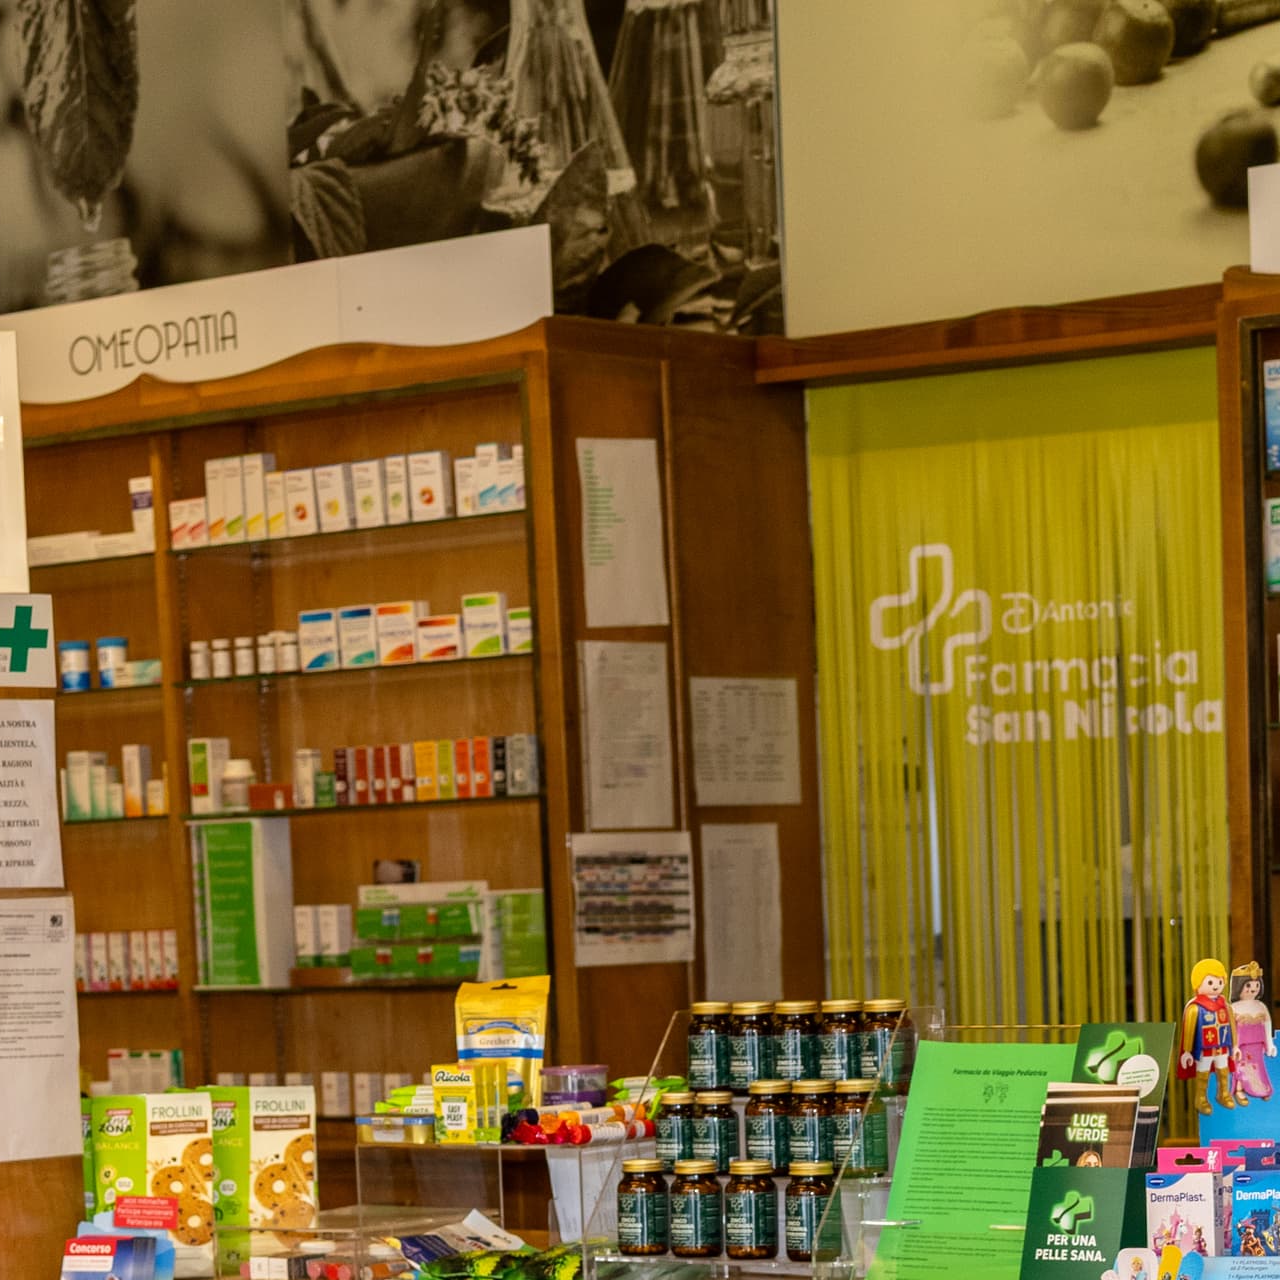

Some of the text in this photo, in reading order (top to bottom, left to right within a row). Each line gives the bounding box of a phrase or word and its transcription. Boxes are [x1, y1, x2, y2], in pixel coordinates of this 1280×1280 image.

[69, 310, 238, 376] OMEOPATIA
[966, 704, 1052, 745] San
[435, 1071, 471, 1082] Ricola
[152, 1106, 202, 1117] FROLLINI
[255, 1100, 306, 1111] FROLLINI
[1073, 1114, 1106, 1128] LUCE
[1068, 1127, 1109, 1141] VERDE
[1047, 1234, 1097, 1246] PER UNA
[70, 1243, 111, 1254] Concorso
[1035, 1248, 1106, 1262] PELLE SANA.
